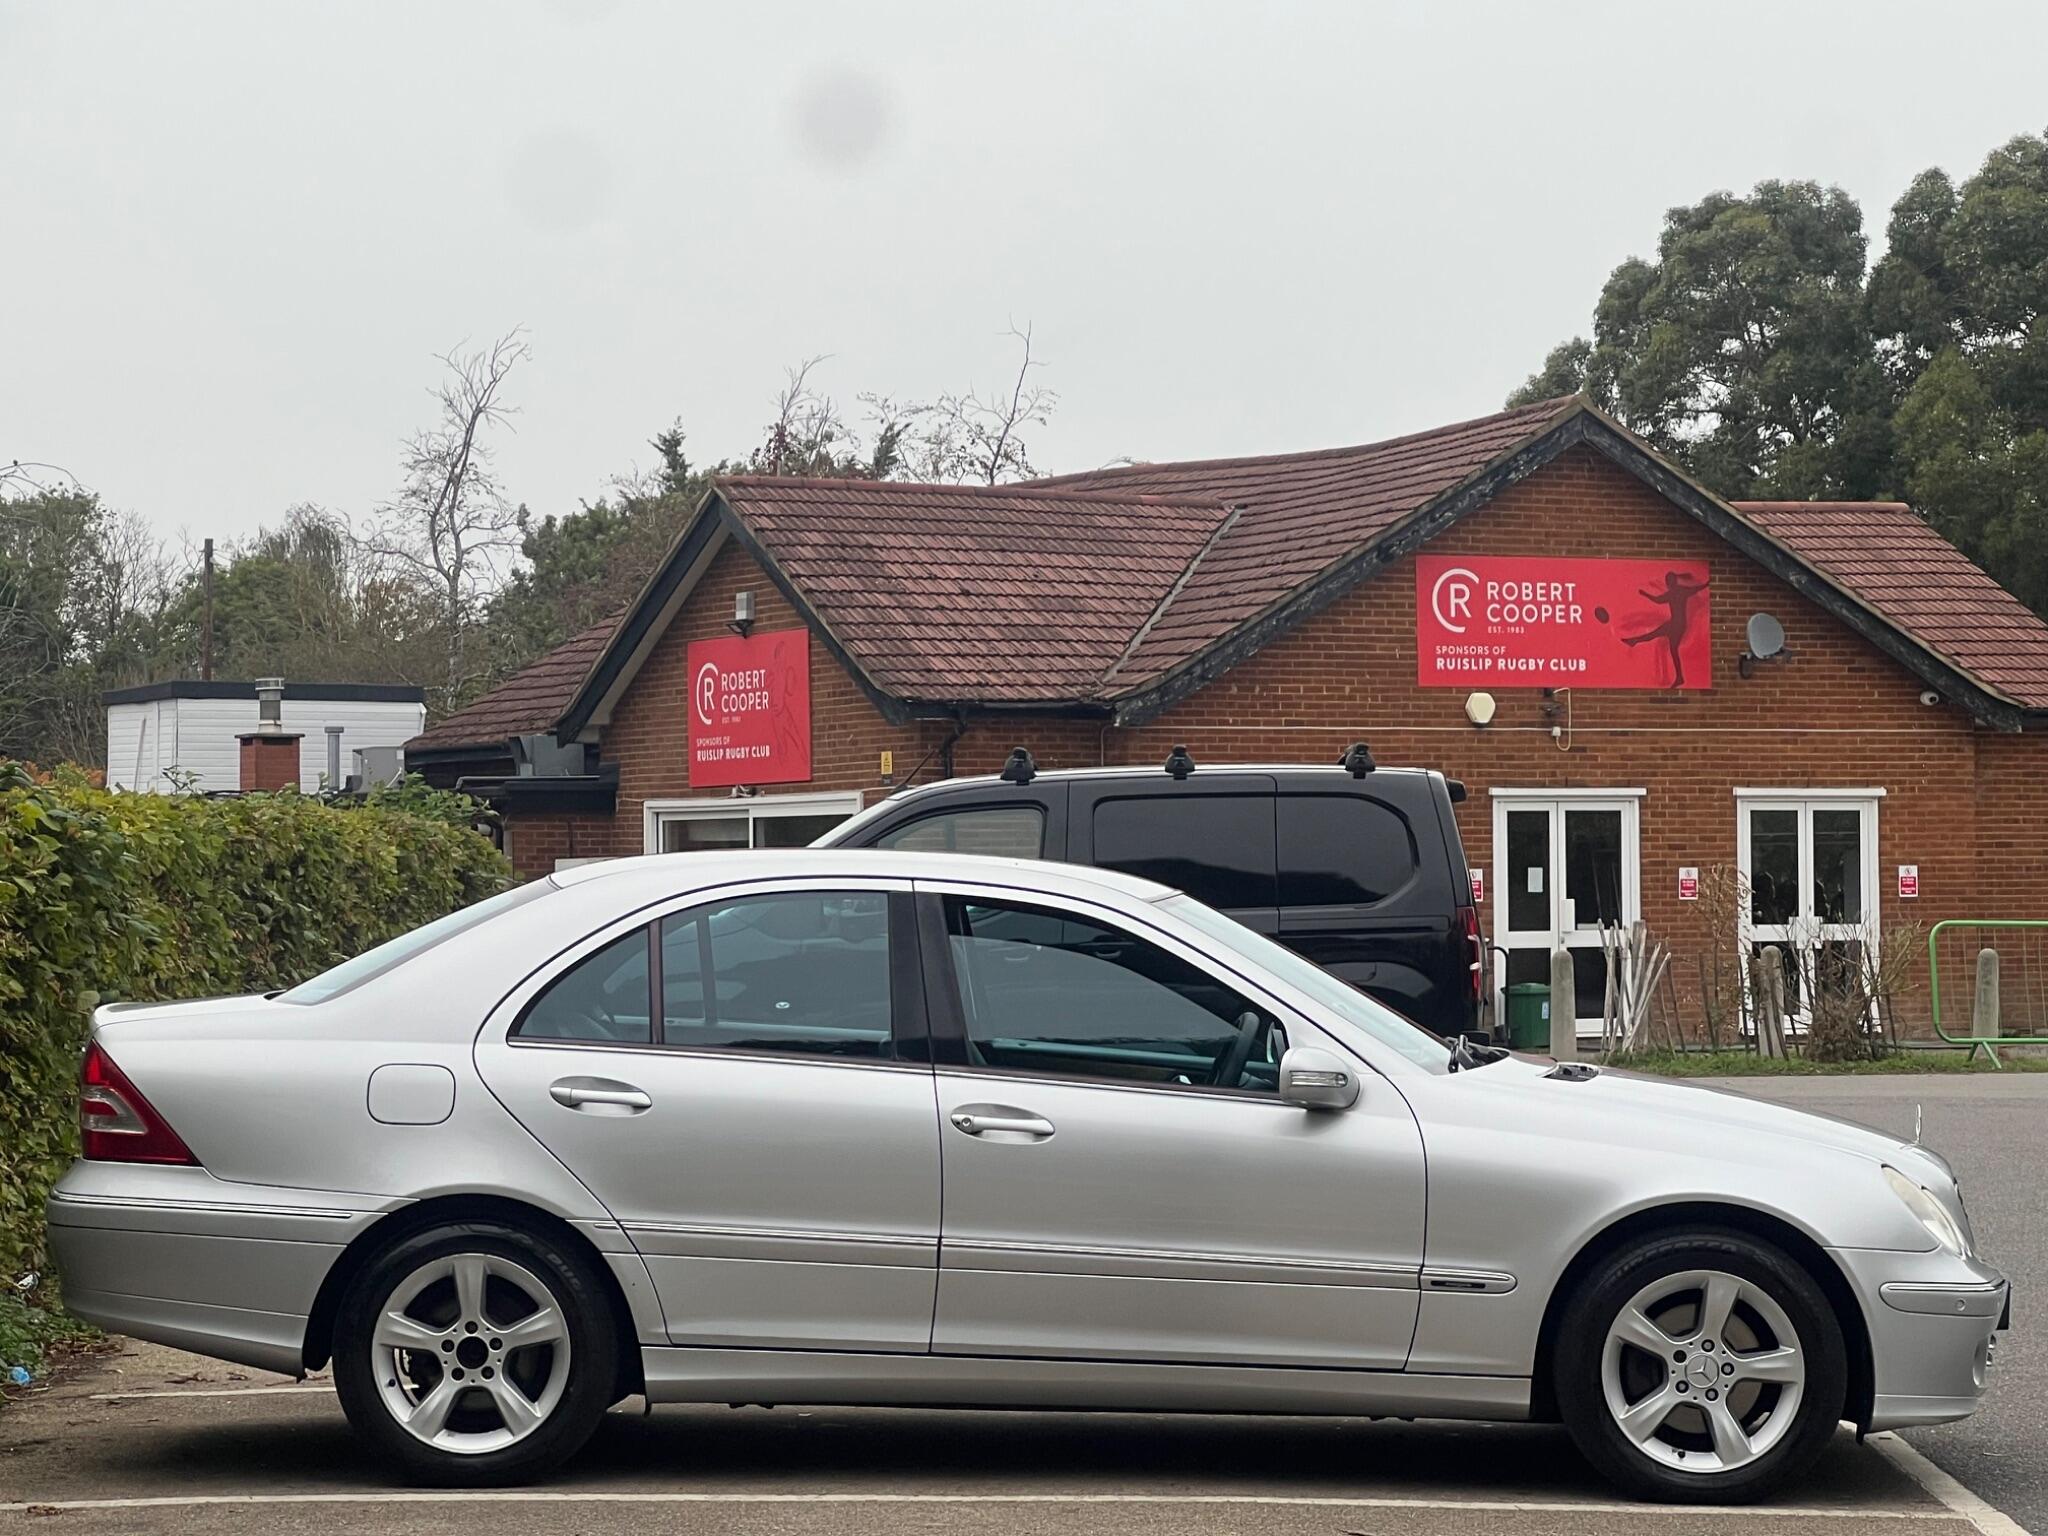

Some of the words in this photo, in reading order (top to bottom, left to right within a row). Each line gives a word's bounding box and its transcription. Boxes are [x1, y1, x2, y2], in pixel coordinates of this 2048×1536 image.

[1487, 581, 1576, 601] ROBERT
[1487, 604, 1582, 624] COOPER
[1435, 645, 1489, 655] SPONSORS
[1492, 646, 1506, 655] OF
[1436, 658, 1492, 670] RUISLIP
[1498, 658, 1545, 671] RUGBY
[1550, 659, 1586, 671] CLUB
[721, 669, 766, 691] ROBERT
[721, 691, 769, 713] COOPER
[696, 736, 722, 747] SPONSORS
[723, 736, 730, 745] OF
[697, 748, 723, 761] RUISLIP
[725, 746, 749, 759] RUGBY
[752, 745, 770, 758] CLUB
